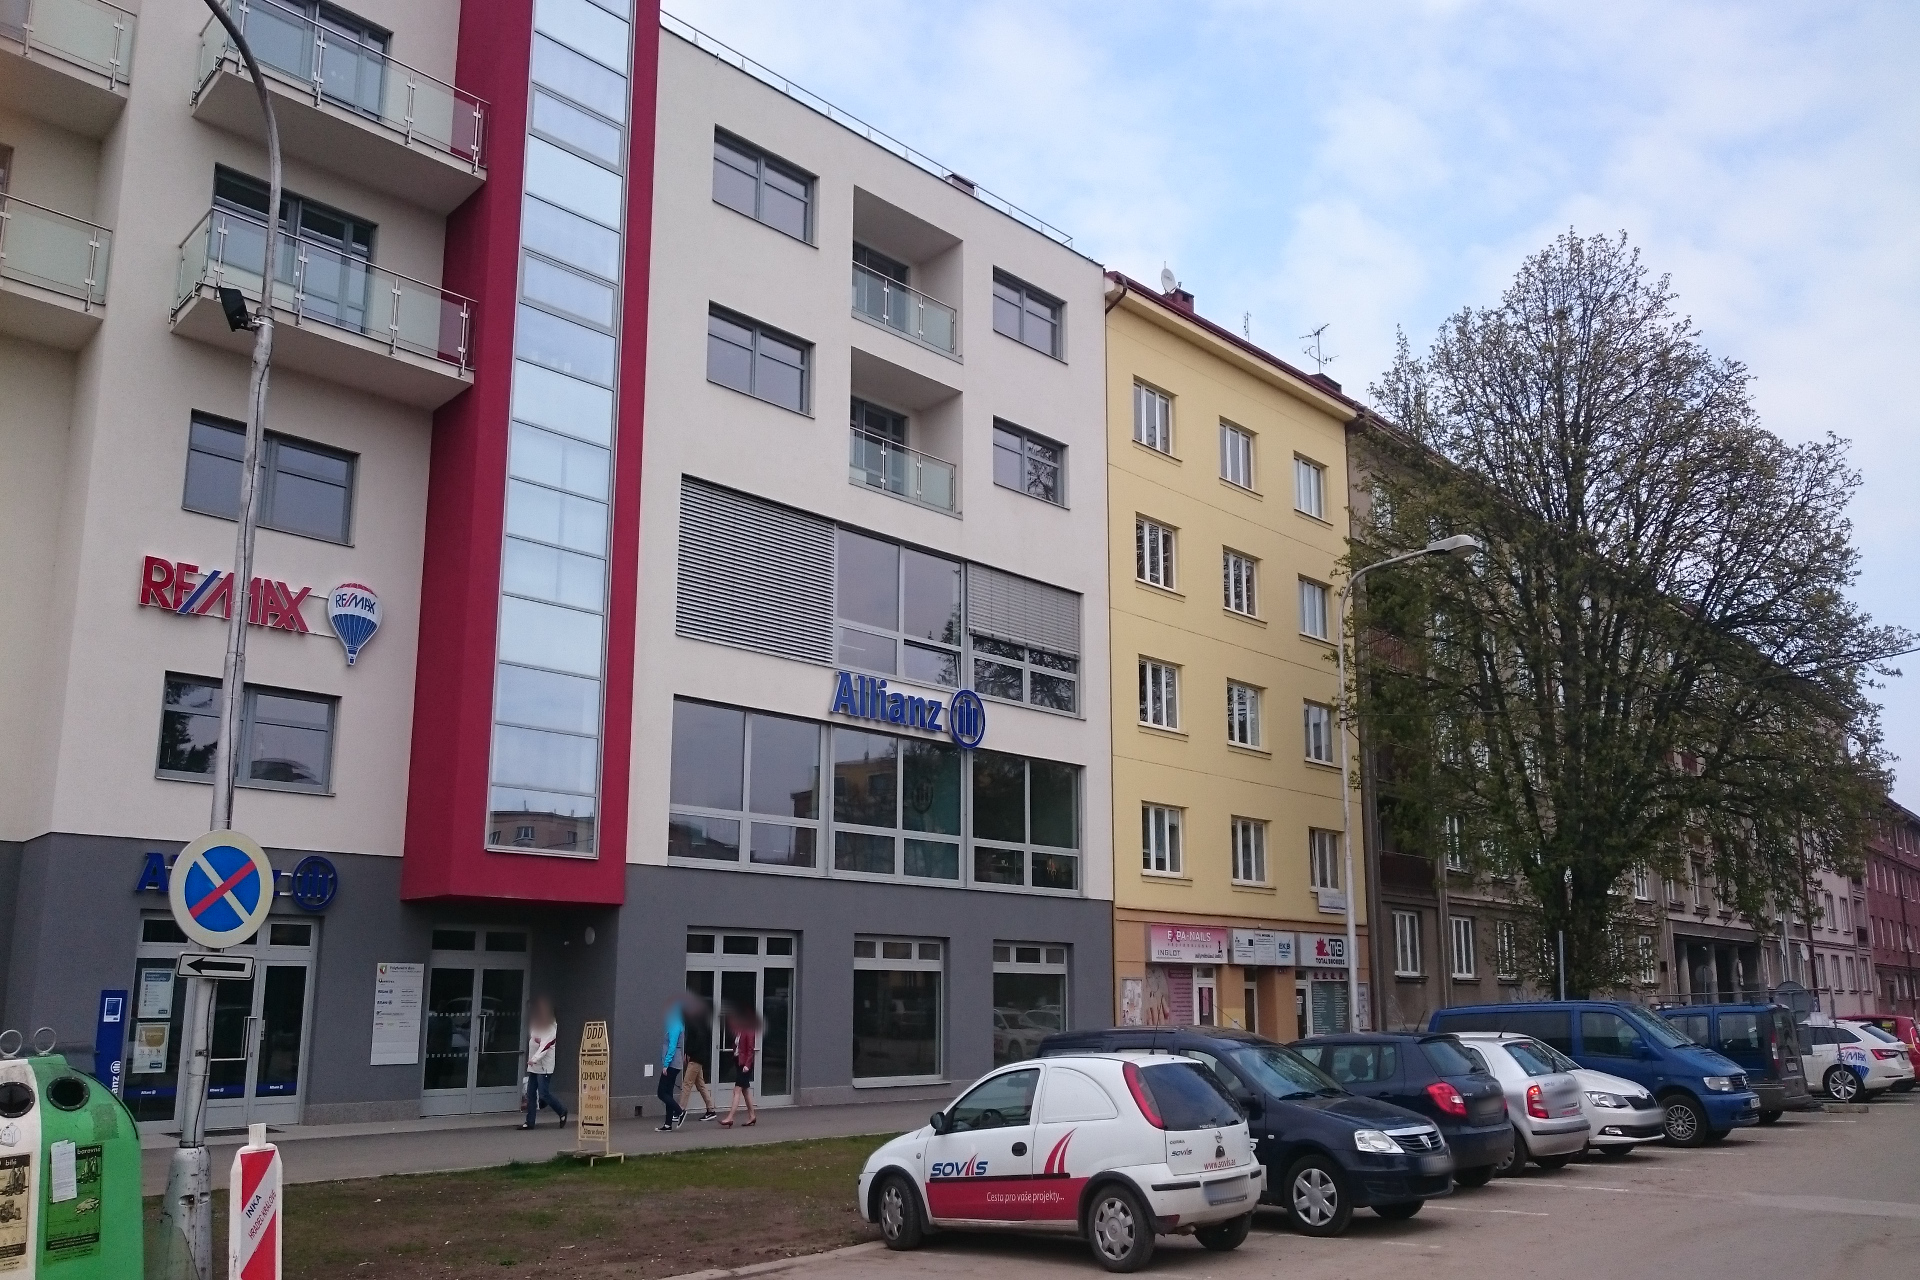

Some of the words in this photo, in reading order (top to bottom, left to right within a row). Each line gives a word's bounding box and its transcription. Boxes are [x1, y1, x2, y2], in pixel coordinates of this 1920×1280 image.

[140, 555, 314, 632] RE/MAX
[335, 593, 377, 615] RE/MAX
[831, 671, 944, 731] Allianz
[1167, 929, 1212, 942] EXPA-NAILS
[1157, 949, 1181, 957] INGLOT
[1316, 957, 1328, 965] TOTAL
[586, 1026, 603, 1040] DDD
[986, 1191, 1004, 1202] Cesta
[1005, 1194, 1016, 1204] pro
[1016, 1191, 1032, 1201] vaše
[1032, 1190, 1065, 1204] projekty...
[245, 1194, 262, 1219] INKA
[248, 1214, 264, 1240] HRADEC
